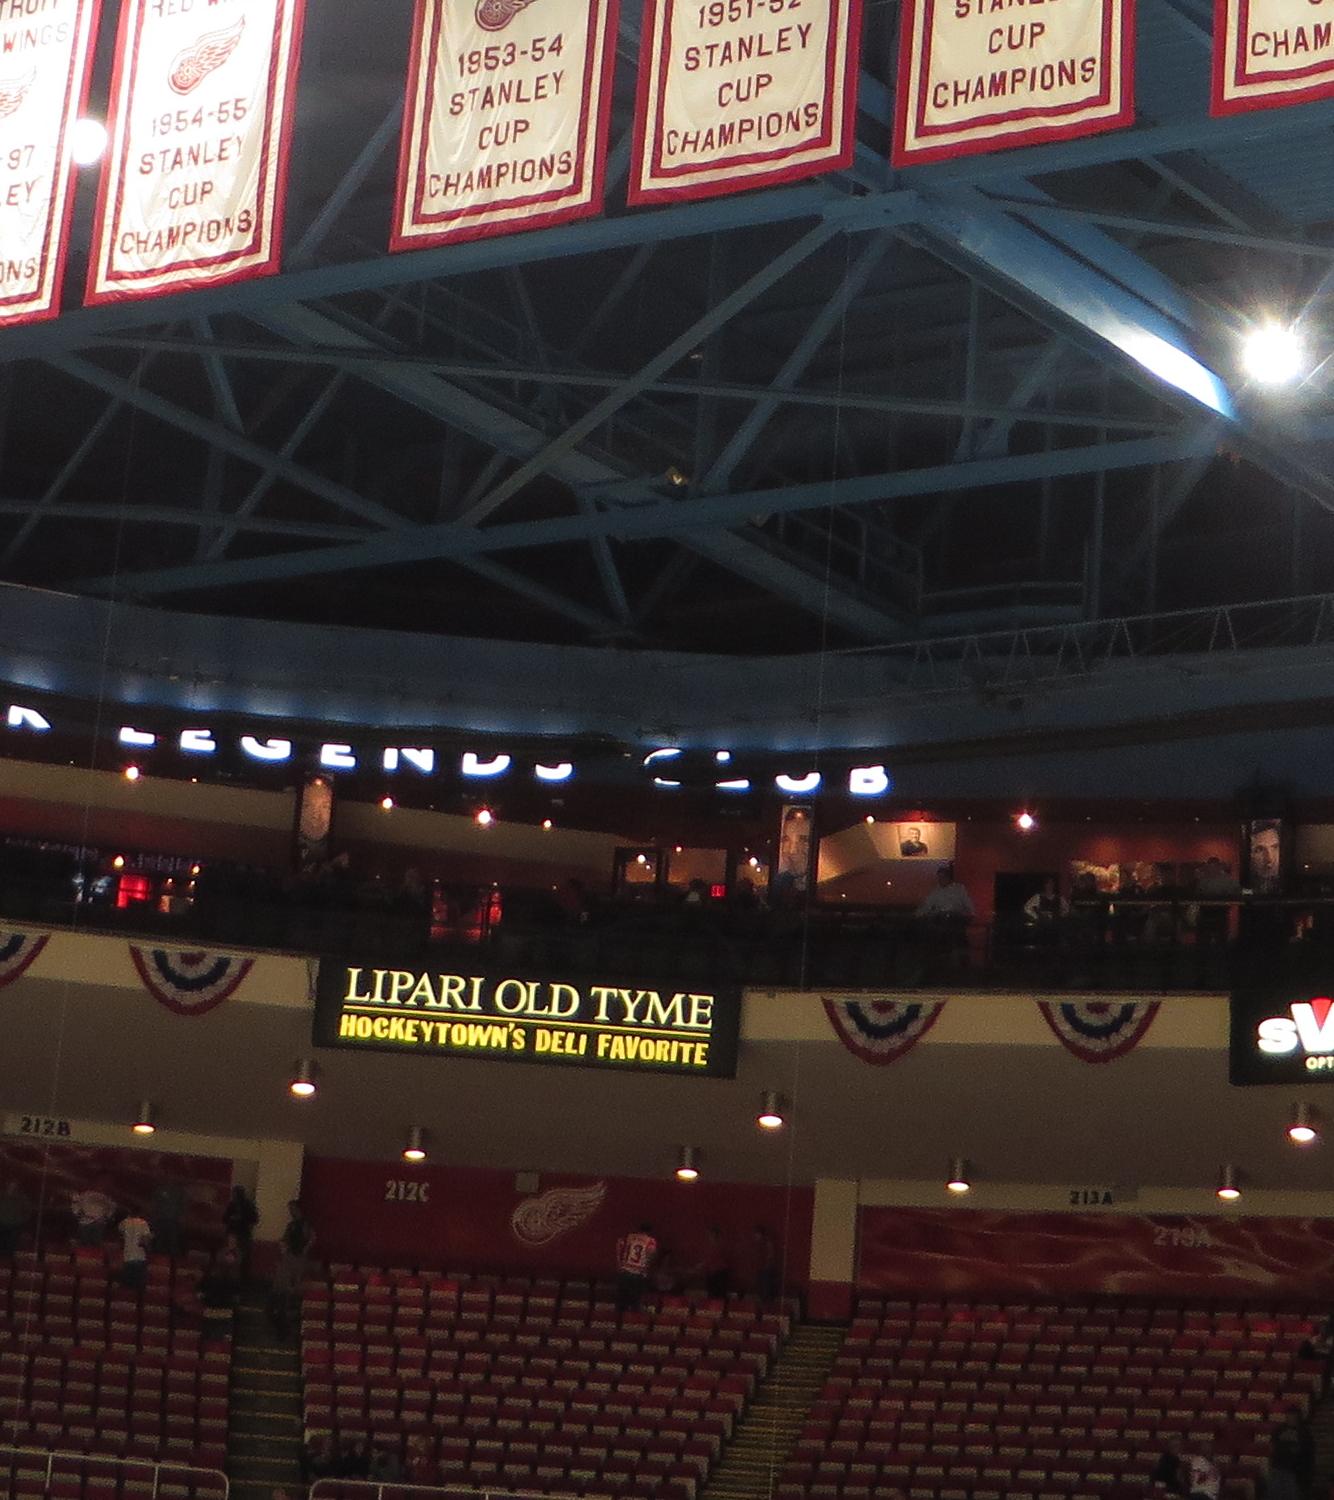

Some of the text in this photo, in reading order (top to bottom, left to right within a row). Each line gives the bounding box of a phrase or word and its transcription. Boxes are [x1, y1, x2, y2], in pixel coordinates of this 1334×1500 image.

[3, 23, 68, 52] WINGS
[458, 34, 563, 76] 1953-54
[685, 23, 811, 71] STANLEY
[988, 23, 1045, 53] CUP
[449, 70, 564, 115] STANLEY
[718, 74, 772, 106] CUP
[933, 58, 1096, 109] CHAMPIONS
[152, 98, 247, 137] 1954-55
[478, 119, 529, 149] CUP
[667, 103, 819, 154] CHAMPIONS
[139, 134, 245, 175] STANLEY
[429, 151, 572, 196] CHAMPIONS
[168, 181, 213, 209] CUP
[120, 210, 252, 254] CHAMPIONS
[344, 968, 714, 1029] LIPARI OLD TYME
[340, 1013, 709, 1065] HOCKEYTOWN'S DELI FAVORITE
[21, 1115, 71, 1136] 212B
